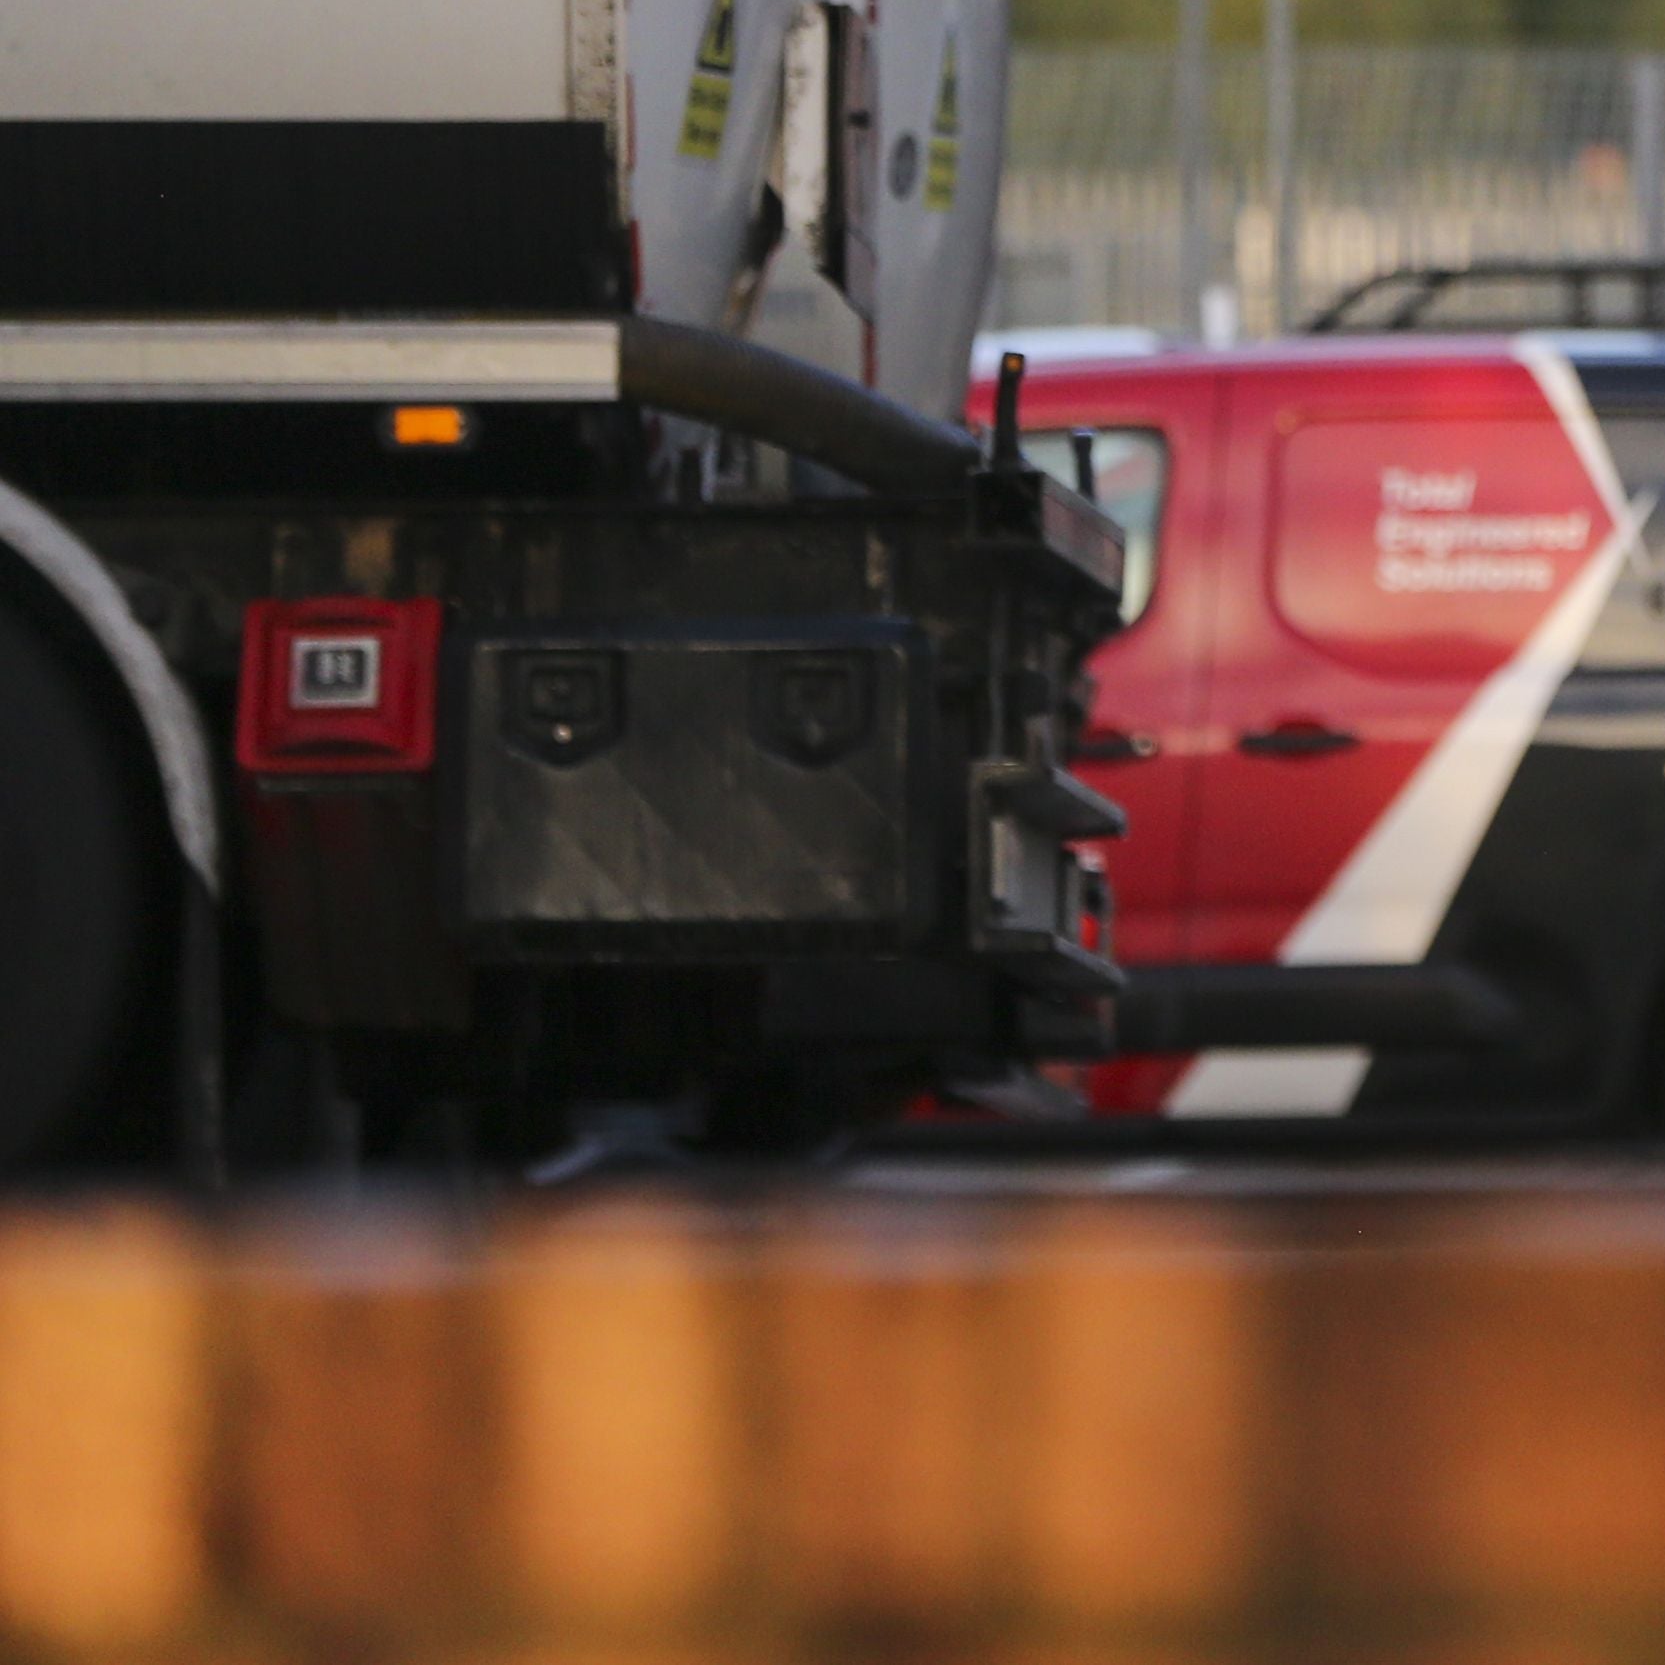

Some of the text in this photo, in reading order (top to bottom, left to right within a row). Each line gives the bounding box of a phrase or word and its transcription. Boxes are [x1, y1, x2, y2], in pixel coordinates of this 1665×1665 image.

[1380, 468, 1477, 510] Total
[1377, 508, 1591, 560] Engineered
[1377, 554, 1554, 591] Solutions
